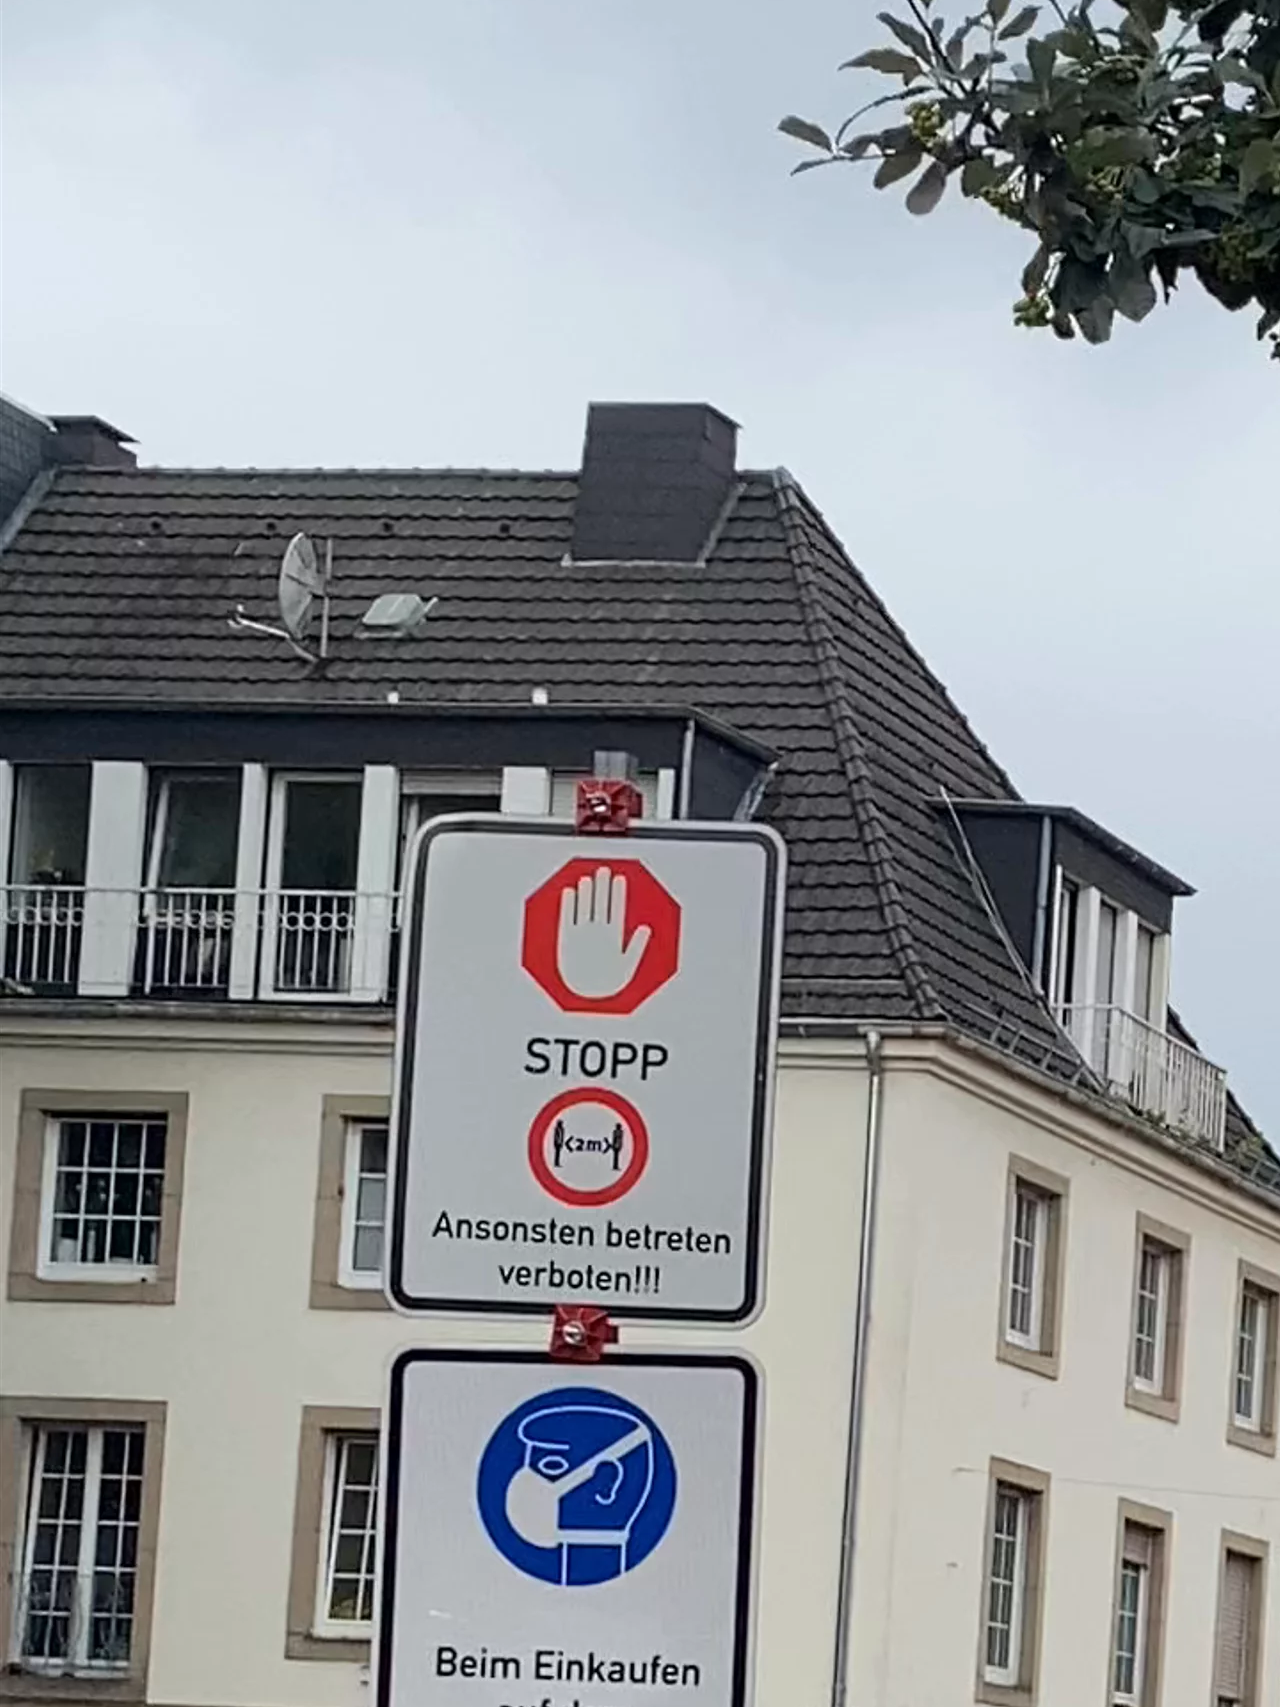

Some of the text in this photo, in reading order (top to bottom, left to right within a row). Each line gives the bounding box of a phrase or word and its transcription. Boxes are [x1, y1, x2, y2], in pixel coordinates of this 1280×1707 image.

[524, 1038, 669, 1081] STOPP
[432, 1211, 732, 1255] Ansonsten betreten
[499, 1261, 661, 1294] verboten!!!
[436, 1647, 701, 1687] Beim Einkaufen
